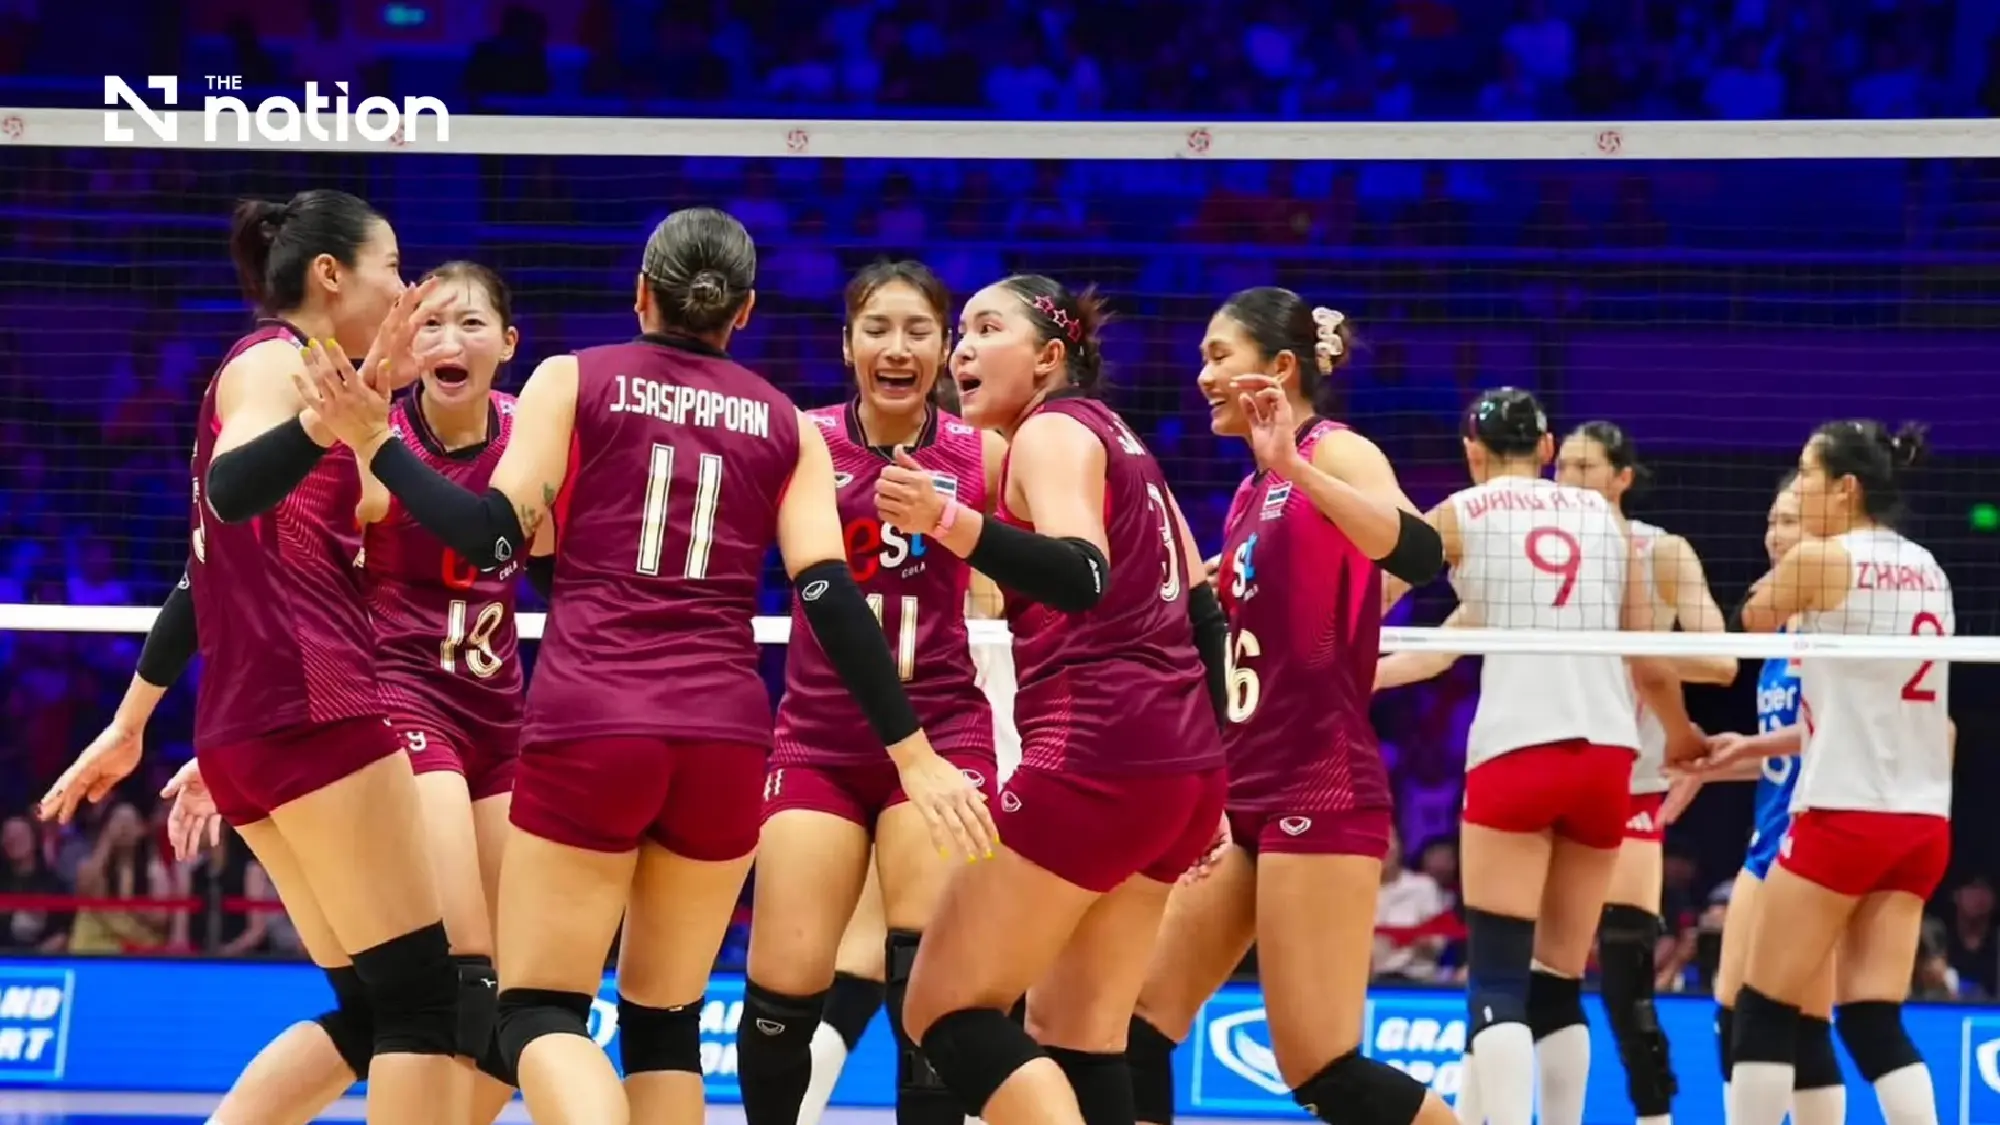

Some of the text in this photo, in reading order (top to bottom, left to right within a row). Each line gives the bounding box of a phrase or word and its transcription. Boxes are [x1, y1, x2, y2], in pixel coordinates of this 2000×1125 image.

[610, 375, 769, 438] J.SASIPAPORN
[636, 443, 723, 580] 11
[1147, 482, 1180, 602] 3
[1525, 525, 1581, 609] 9
[1901, 611, 1945, 701] 2
[0, 986, 63, 1020] ND
